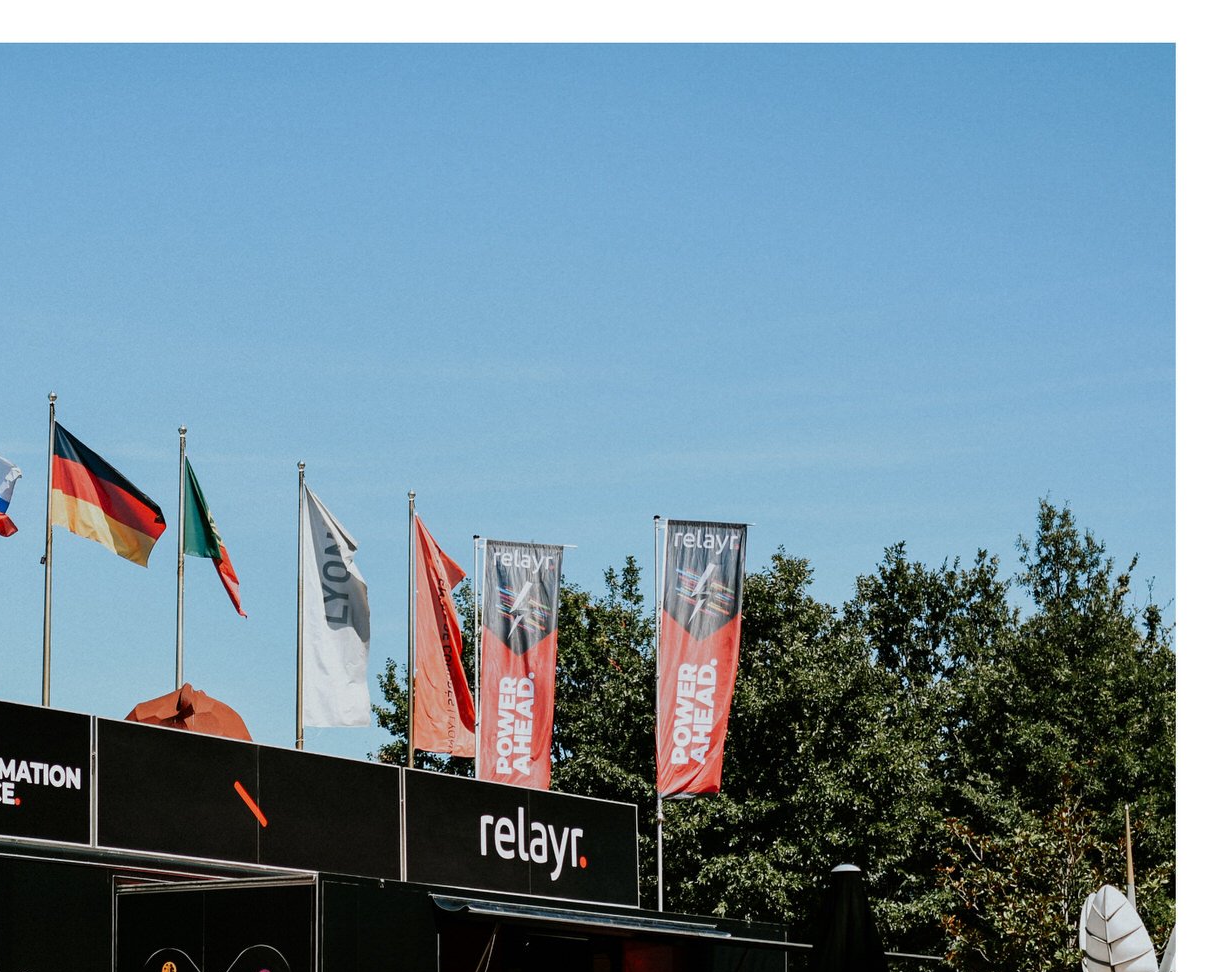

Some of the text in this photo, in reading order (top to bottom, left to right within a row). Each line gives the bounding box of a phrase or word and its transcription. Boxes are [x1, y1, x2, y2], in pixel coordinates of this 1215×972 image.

[493, 549, 554, 575] relayr.
[674, 532, 739, 556] relayr.
[496, 676, 517, 775] POWER
[512, 671, 535, 776] AHEAD.
[671, 663, 698, 766] POWER
[689, 658, 718, 766] AHEAD.
[480, 806, 587, 881] relayr.
